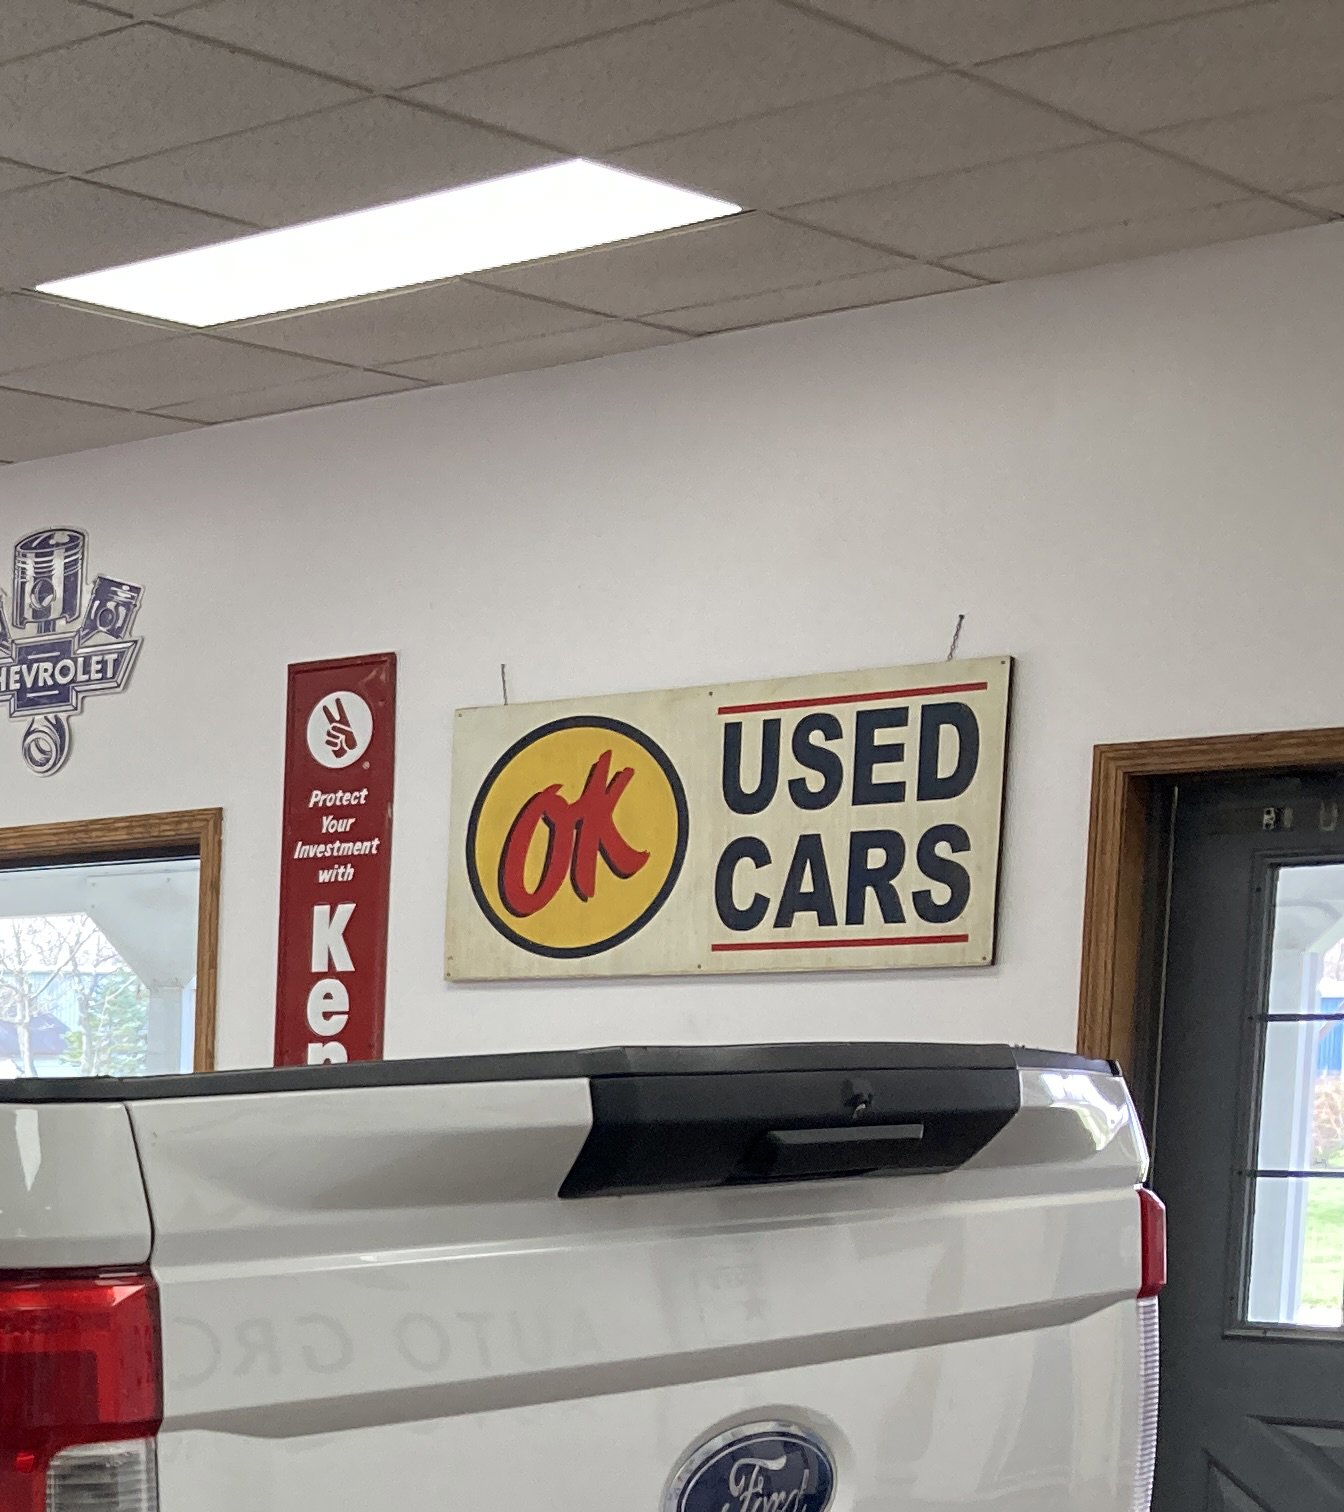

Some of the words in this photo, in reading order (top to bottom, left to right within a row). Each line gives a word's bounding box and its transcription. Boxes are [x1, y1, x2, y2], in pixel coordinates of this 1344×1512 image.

[721, 700, 980, 815] USED
[308, 788, 369, 808] Protect
[321, 815, 356, 834] Your
[497, 748, 651, 919] OK
[293, 838, 380, 859] Investment
[318, 863, 355, 883] with
[714, 823, 972, 932] CARS
